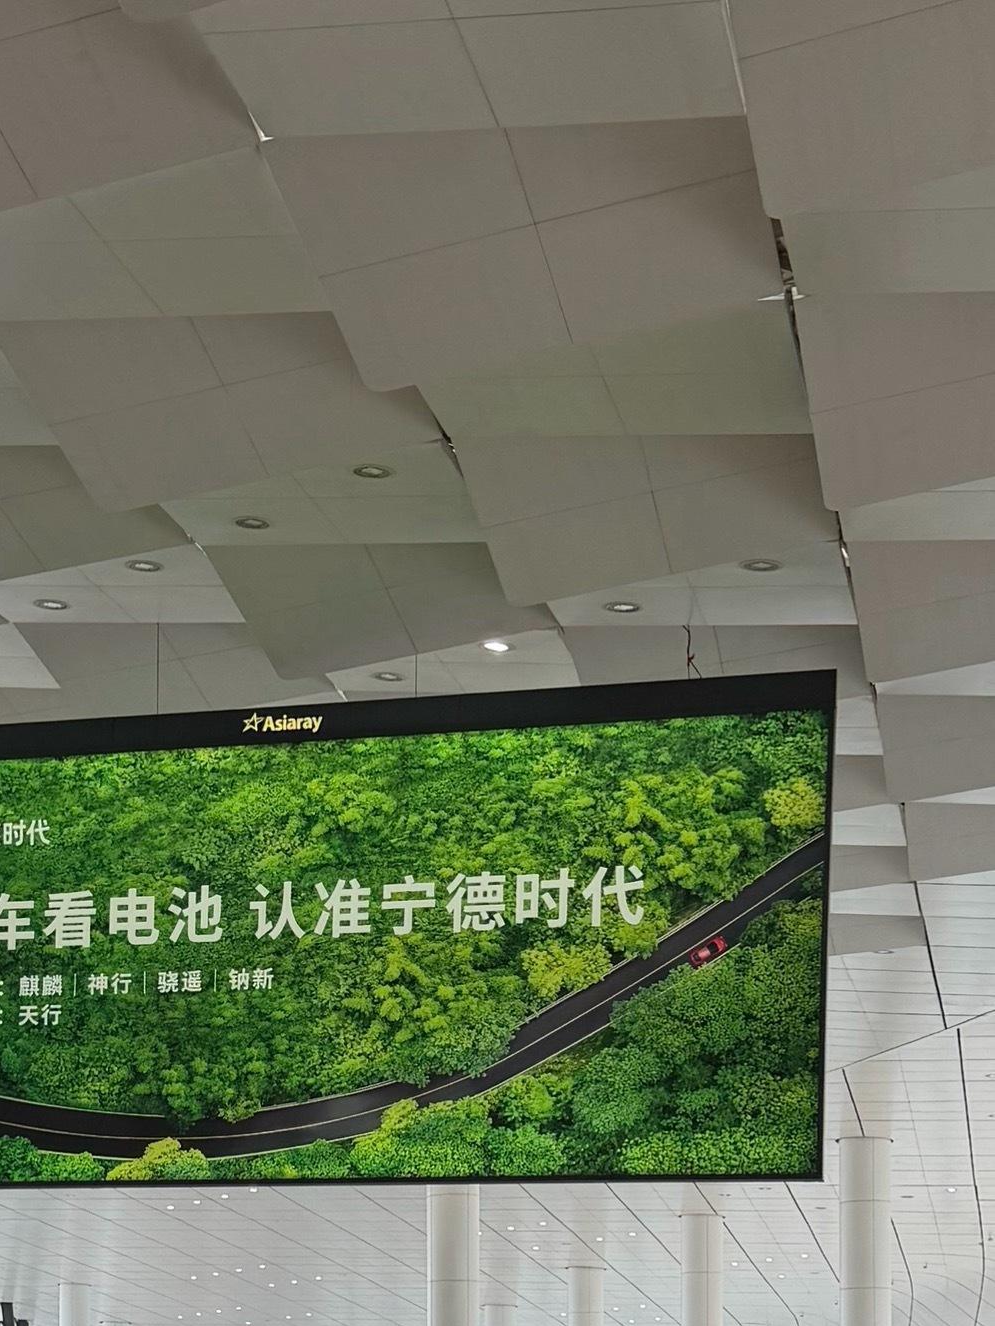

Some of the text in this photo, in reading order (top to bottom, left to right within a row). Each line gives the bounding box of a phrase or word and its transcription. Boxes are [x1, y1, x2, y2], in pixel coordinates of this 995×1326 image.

[261, 712, 323, 734] Asiaray
[249, 865, 646, 940] 认准宁德时代
[18, 973, 64, 997] 麒麟
[87, 972, 132, 996] 神行
[157, 970, 202, 994] 骁遥
[228, 967, 274, 991] 钠新
[18, 1003, 63, 1027] 天行
